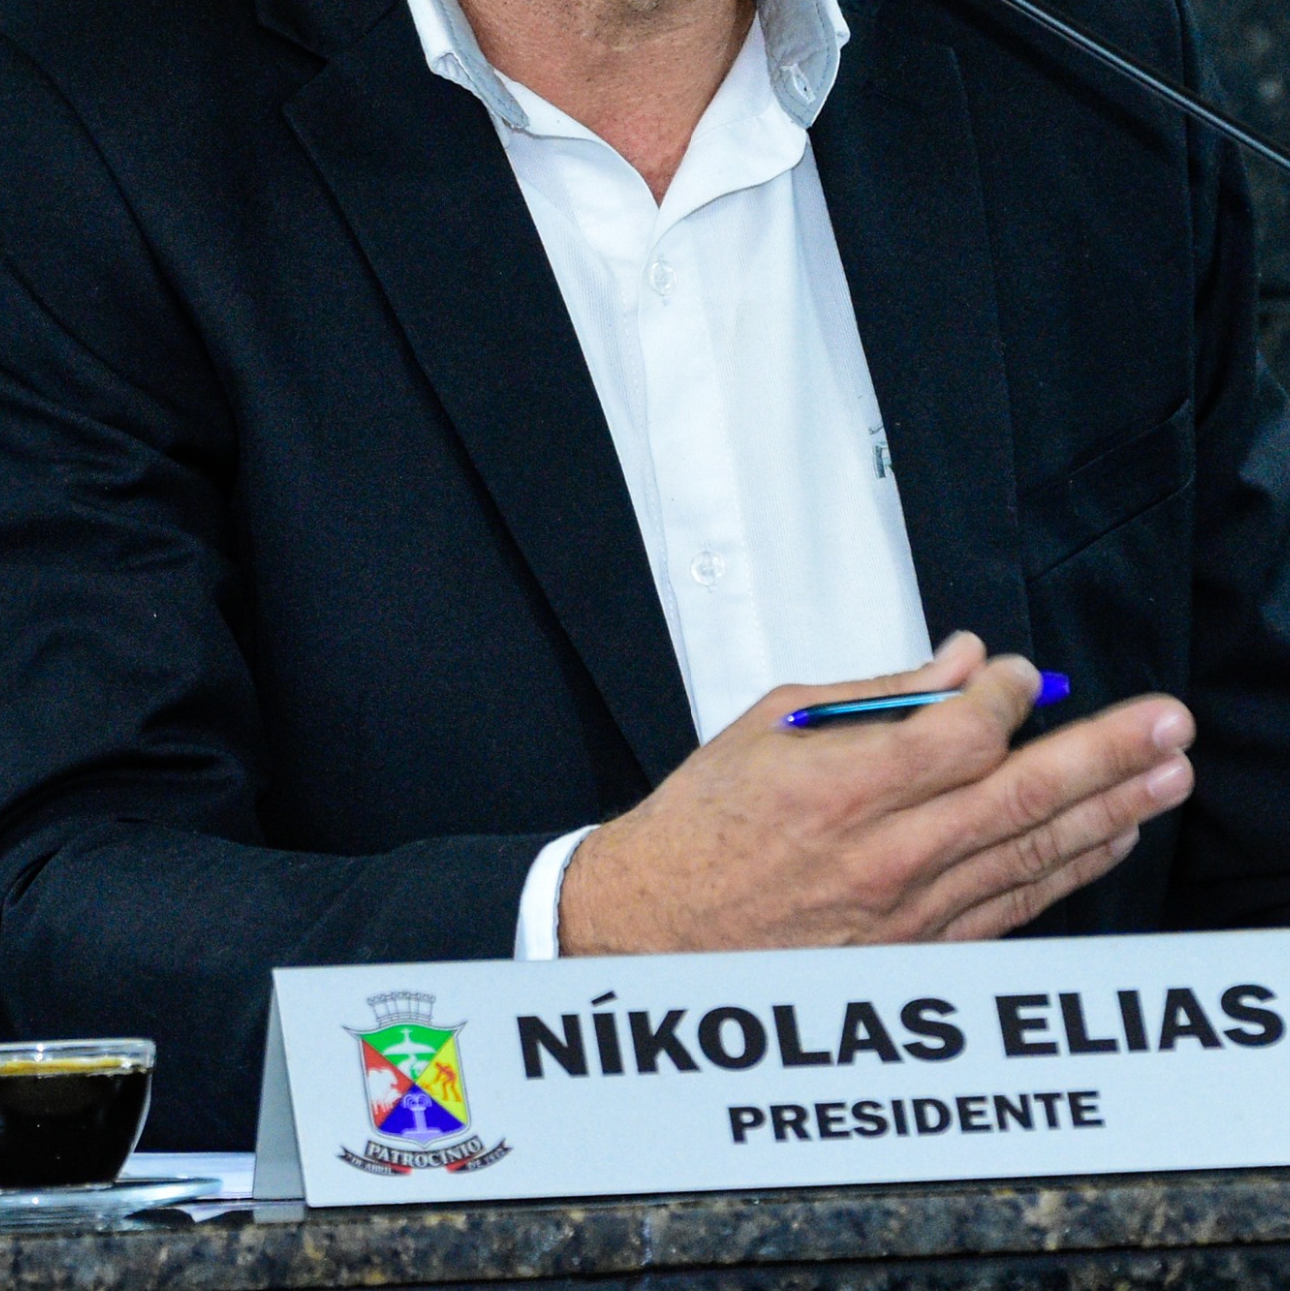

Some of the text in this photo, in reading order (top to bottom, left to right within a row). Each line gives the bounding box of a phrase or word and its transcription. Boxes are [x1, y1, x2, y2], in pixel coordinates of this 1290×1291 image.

[516, 983, 1286, 1079] NÍKOLAS ELIAS
[728, 1090, 1103, 1143] PRESIDENTE
